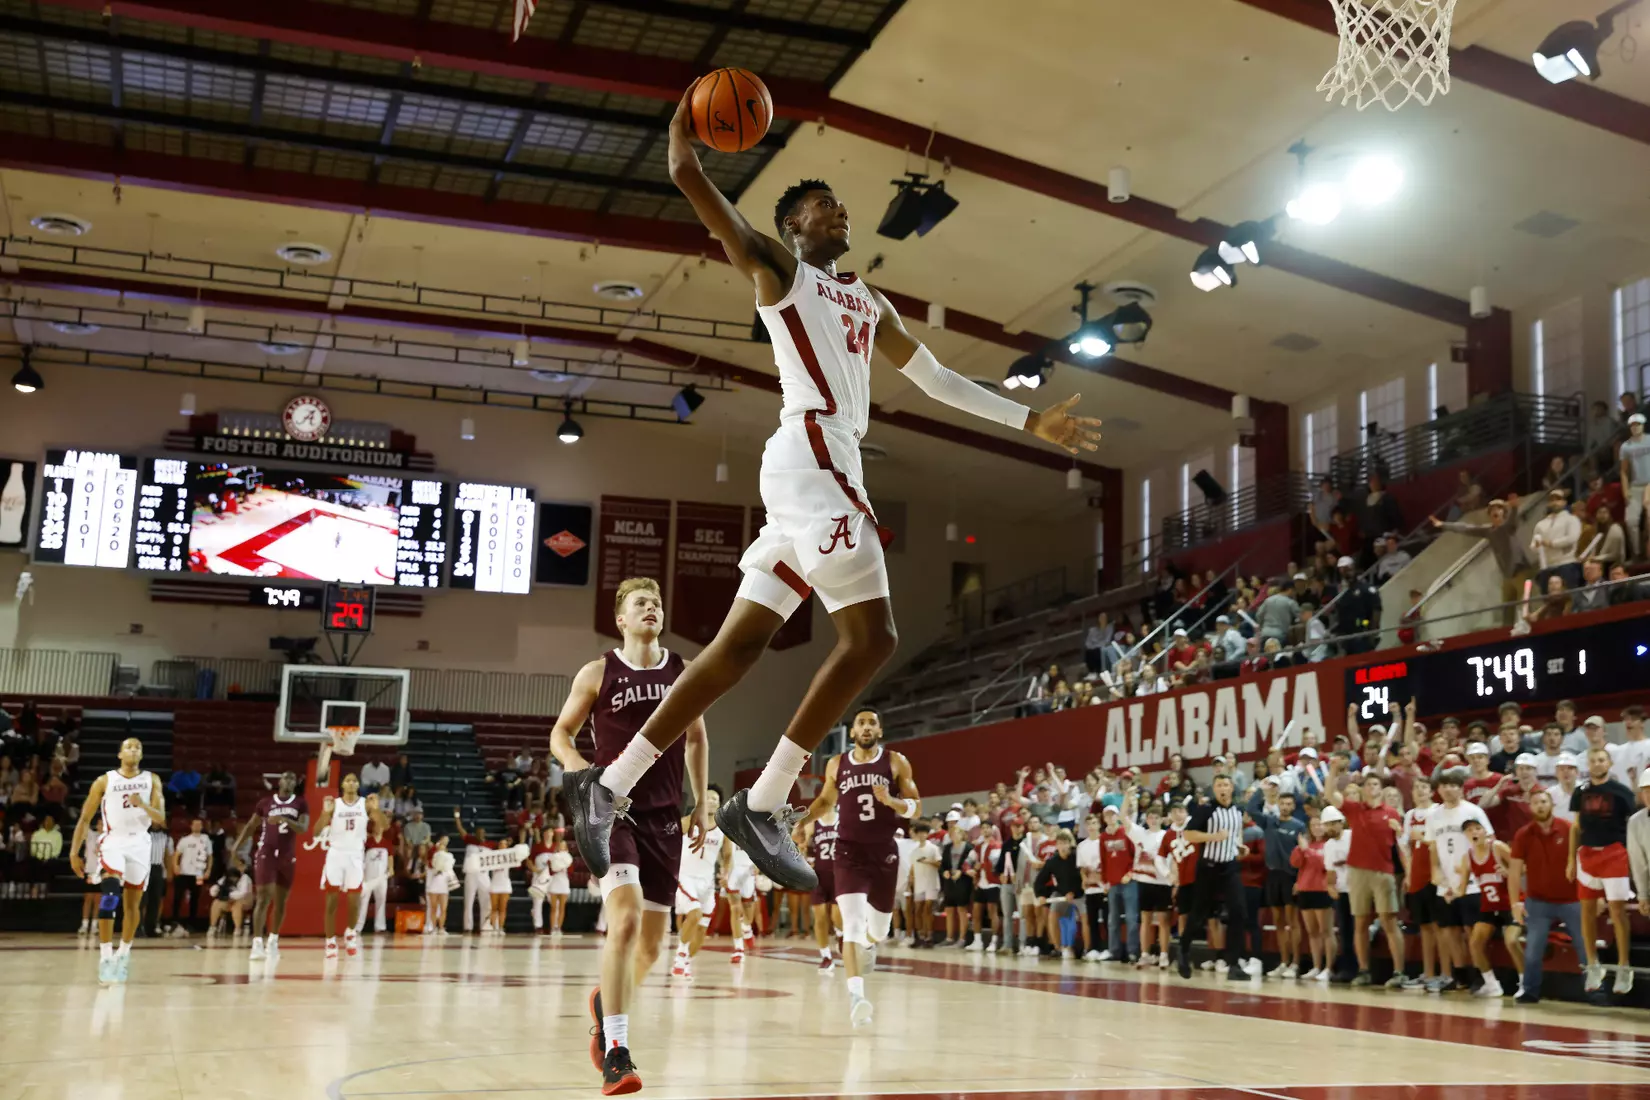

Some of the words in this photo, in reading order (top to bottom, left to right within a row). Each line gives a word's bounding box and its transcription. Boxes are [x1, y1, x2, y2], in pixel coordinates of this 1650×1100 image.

[841, 314, 870, 364] 24
[203, 436, 277, 457] FOSTER
[282, 443, 403, 467] AUDITORIUM
[54, 478, 63, 492] 1
[85, 482, 94, 493] 0
[116, 484, 124, 495] 6
[46, 491, 68, 507] 10
[86, 497, 89, 507] 1
[114, 499, 123, 509] 0
[85, 510, 88, 520] 1
[113, 512, 121, 523] 6
[139, 508, 155, 519] TO
[490, 514, 498, 524] 0
[517, 516, 525, 526] 0
[80, 524, 89, 535] 0
[112, 527, 119, 537] 2
[490, 527, 497, 537] 0
[516, 529, 523, 539] 5
[614, 520, 655, 536] NCAA
[694, 528, 724, 544] SEC
[818, 514, 856, 555] A
[81, 538, 85, 548] 1
[110, 540, 119, 551] 0
[488, 540, 496, 550] 0
[515, 542, 523, 552] 0
[490, 553, 493, 562] 1
[515, 555, 521, 565] 8
[489, 566, 492, 576] 1
[513, 567, 521, 578] 0
[332, 602, 364, 628] 29
[1467, 647, 1535, 697] 7:49
[1579, 649, 1587, 675] 1
[611, 683, 672, 713] SALUK
[1361, 686, 1389, 720] 24
[1101, 671, 1327, 769] ALABAMA
[112, 782, 148, 792] ALABAMA
[839, 773, 890, 795] SALUKIS
[857, 793, 876, 821] 3
[345, 819, 355, 831] 15
[1483, 885, 1500, 902] 2
